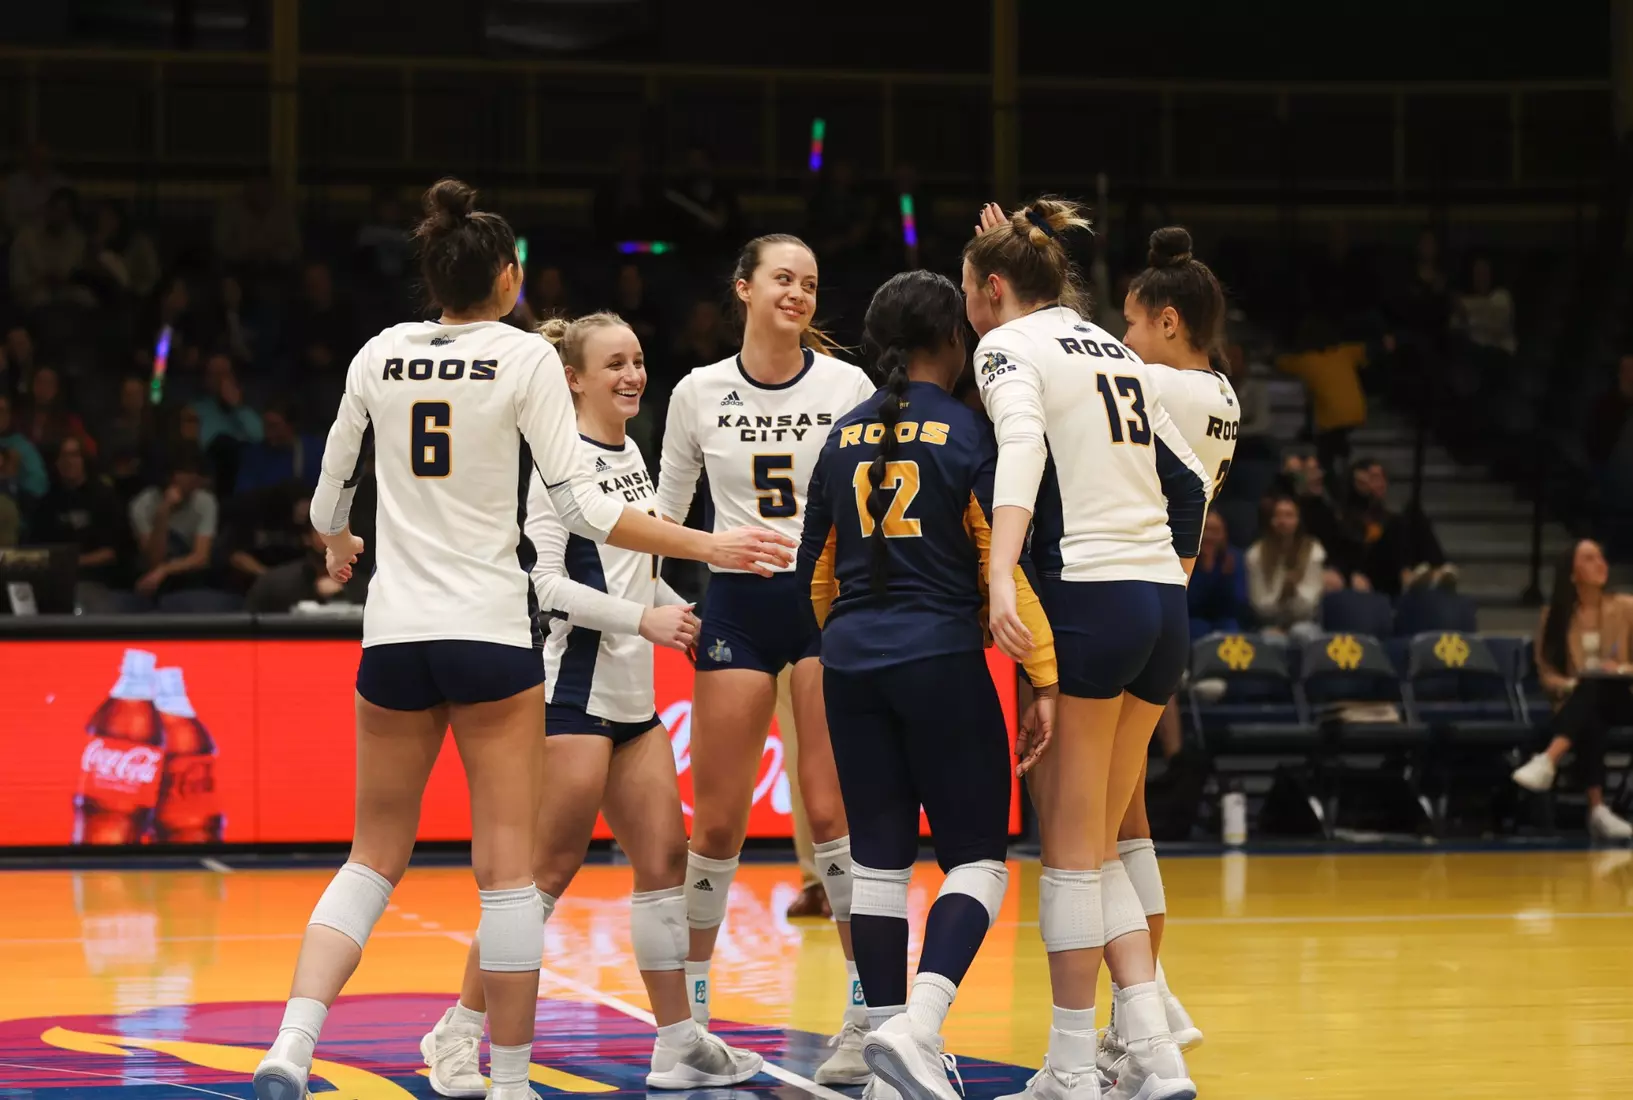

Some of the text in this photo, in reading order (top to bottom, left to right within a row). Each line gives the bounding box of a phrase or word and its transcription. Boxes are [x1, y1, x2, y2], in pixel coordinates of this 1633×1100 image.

[382, 358, 498, 381] ROOS
[718, 413, 832, 428] KANSAS
[1095, 371, 1152, 448] 13
[410, 400, 453, 479] 6
[740, 428, 808, 442] CITY
[839, 421, 950, 449] ROOS
[622, 484, 655, 503] CITY
[751, 453, 800, 520] 5
[852, 460, 923, 538] 12
